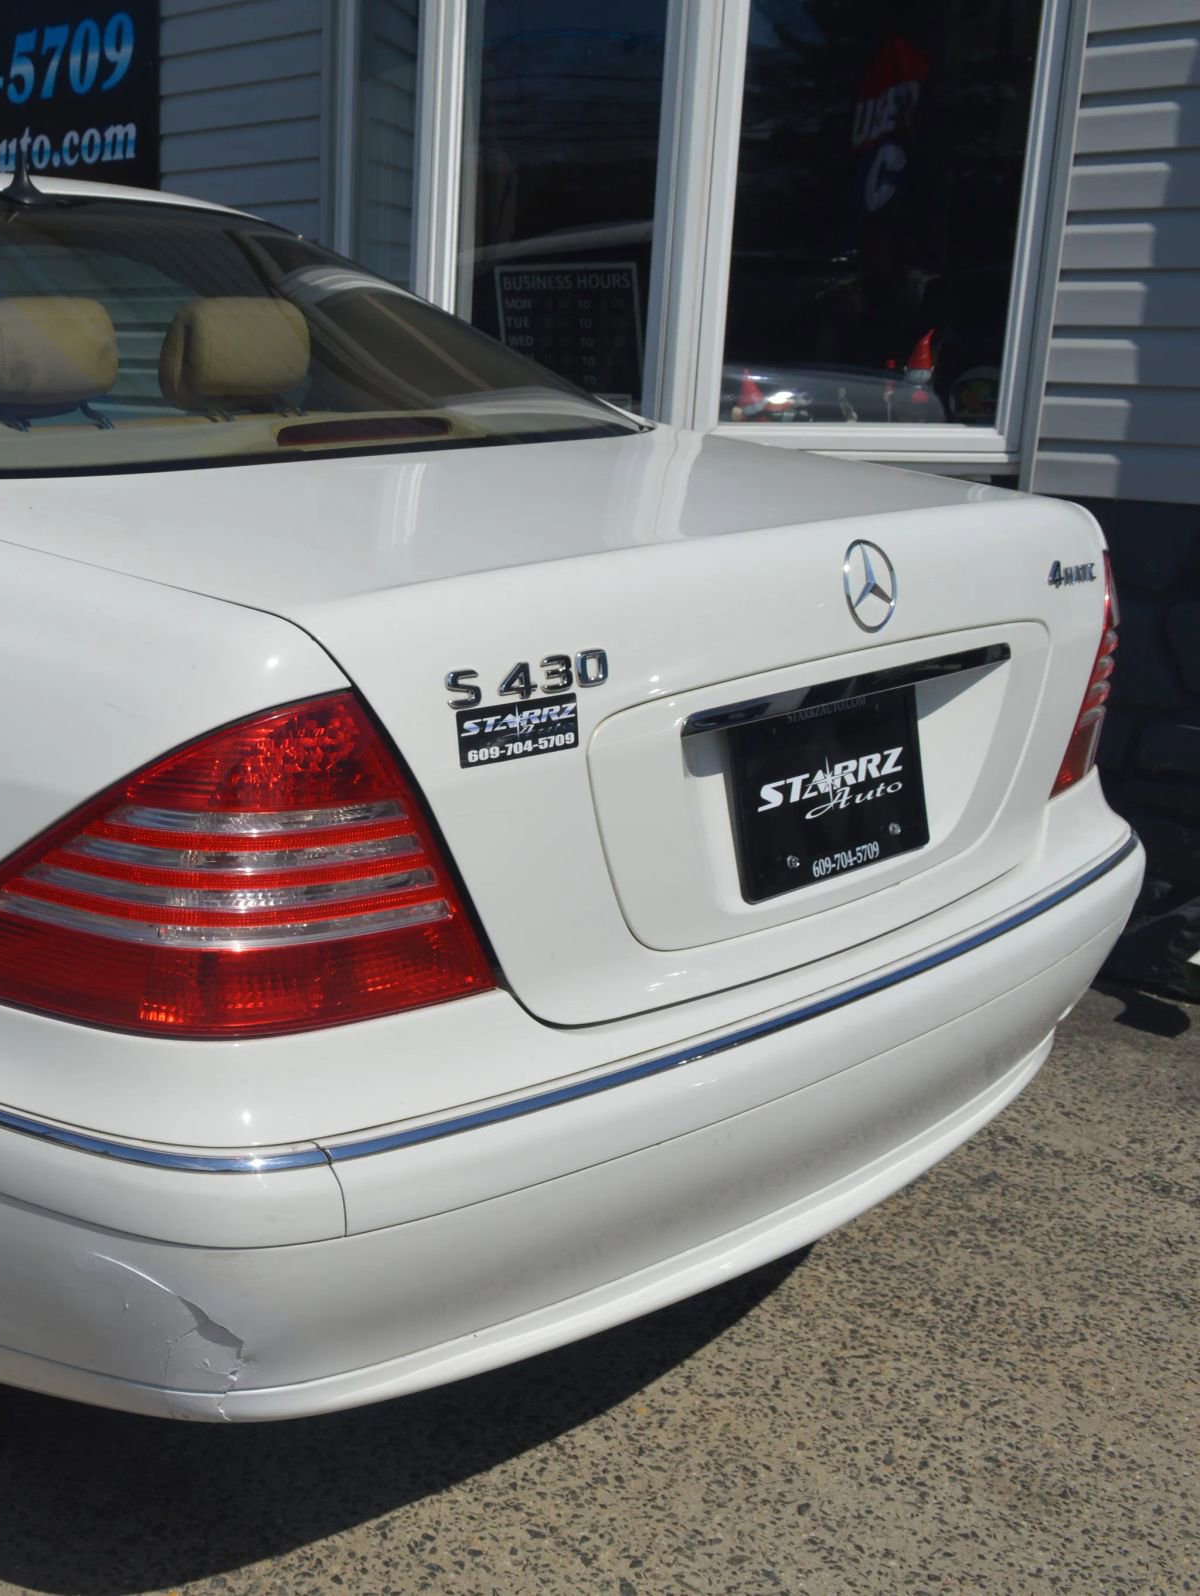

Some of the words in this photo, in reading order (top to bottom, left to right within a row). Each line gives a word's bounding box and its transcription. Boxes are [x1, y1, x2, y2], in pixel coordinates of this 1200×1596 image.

[503, 275, 573, 291] BUSINESS
[577, 273, 631, 289] HOURS
[505, 299, 532, 310] MON
[506, 317, 531, 328] TUE
[508, 336, 534, 346] WED
[445, 669, 482, 710] S
[497, 648, 609, 700] 430
[461, 702, 577, 738] STARRZ
[467, 732, 576, 763] 609-704-5709
[757, 747, 903, 812] STARRZ
[805, 781, 903, 819] Auto
[812, 841, 880, 877] 609-704-5709
